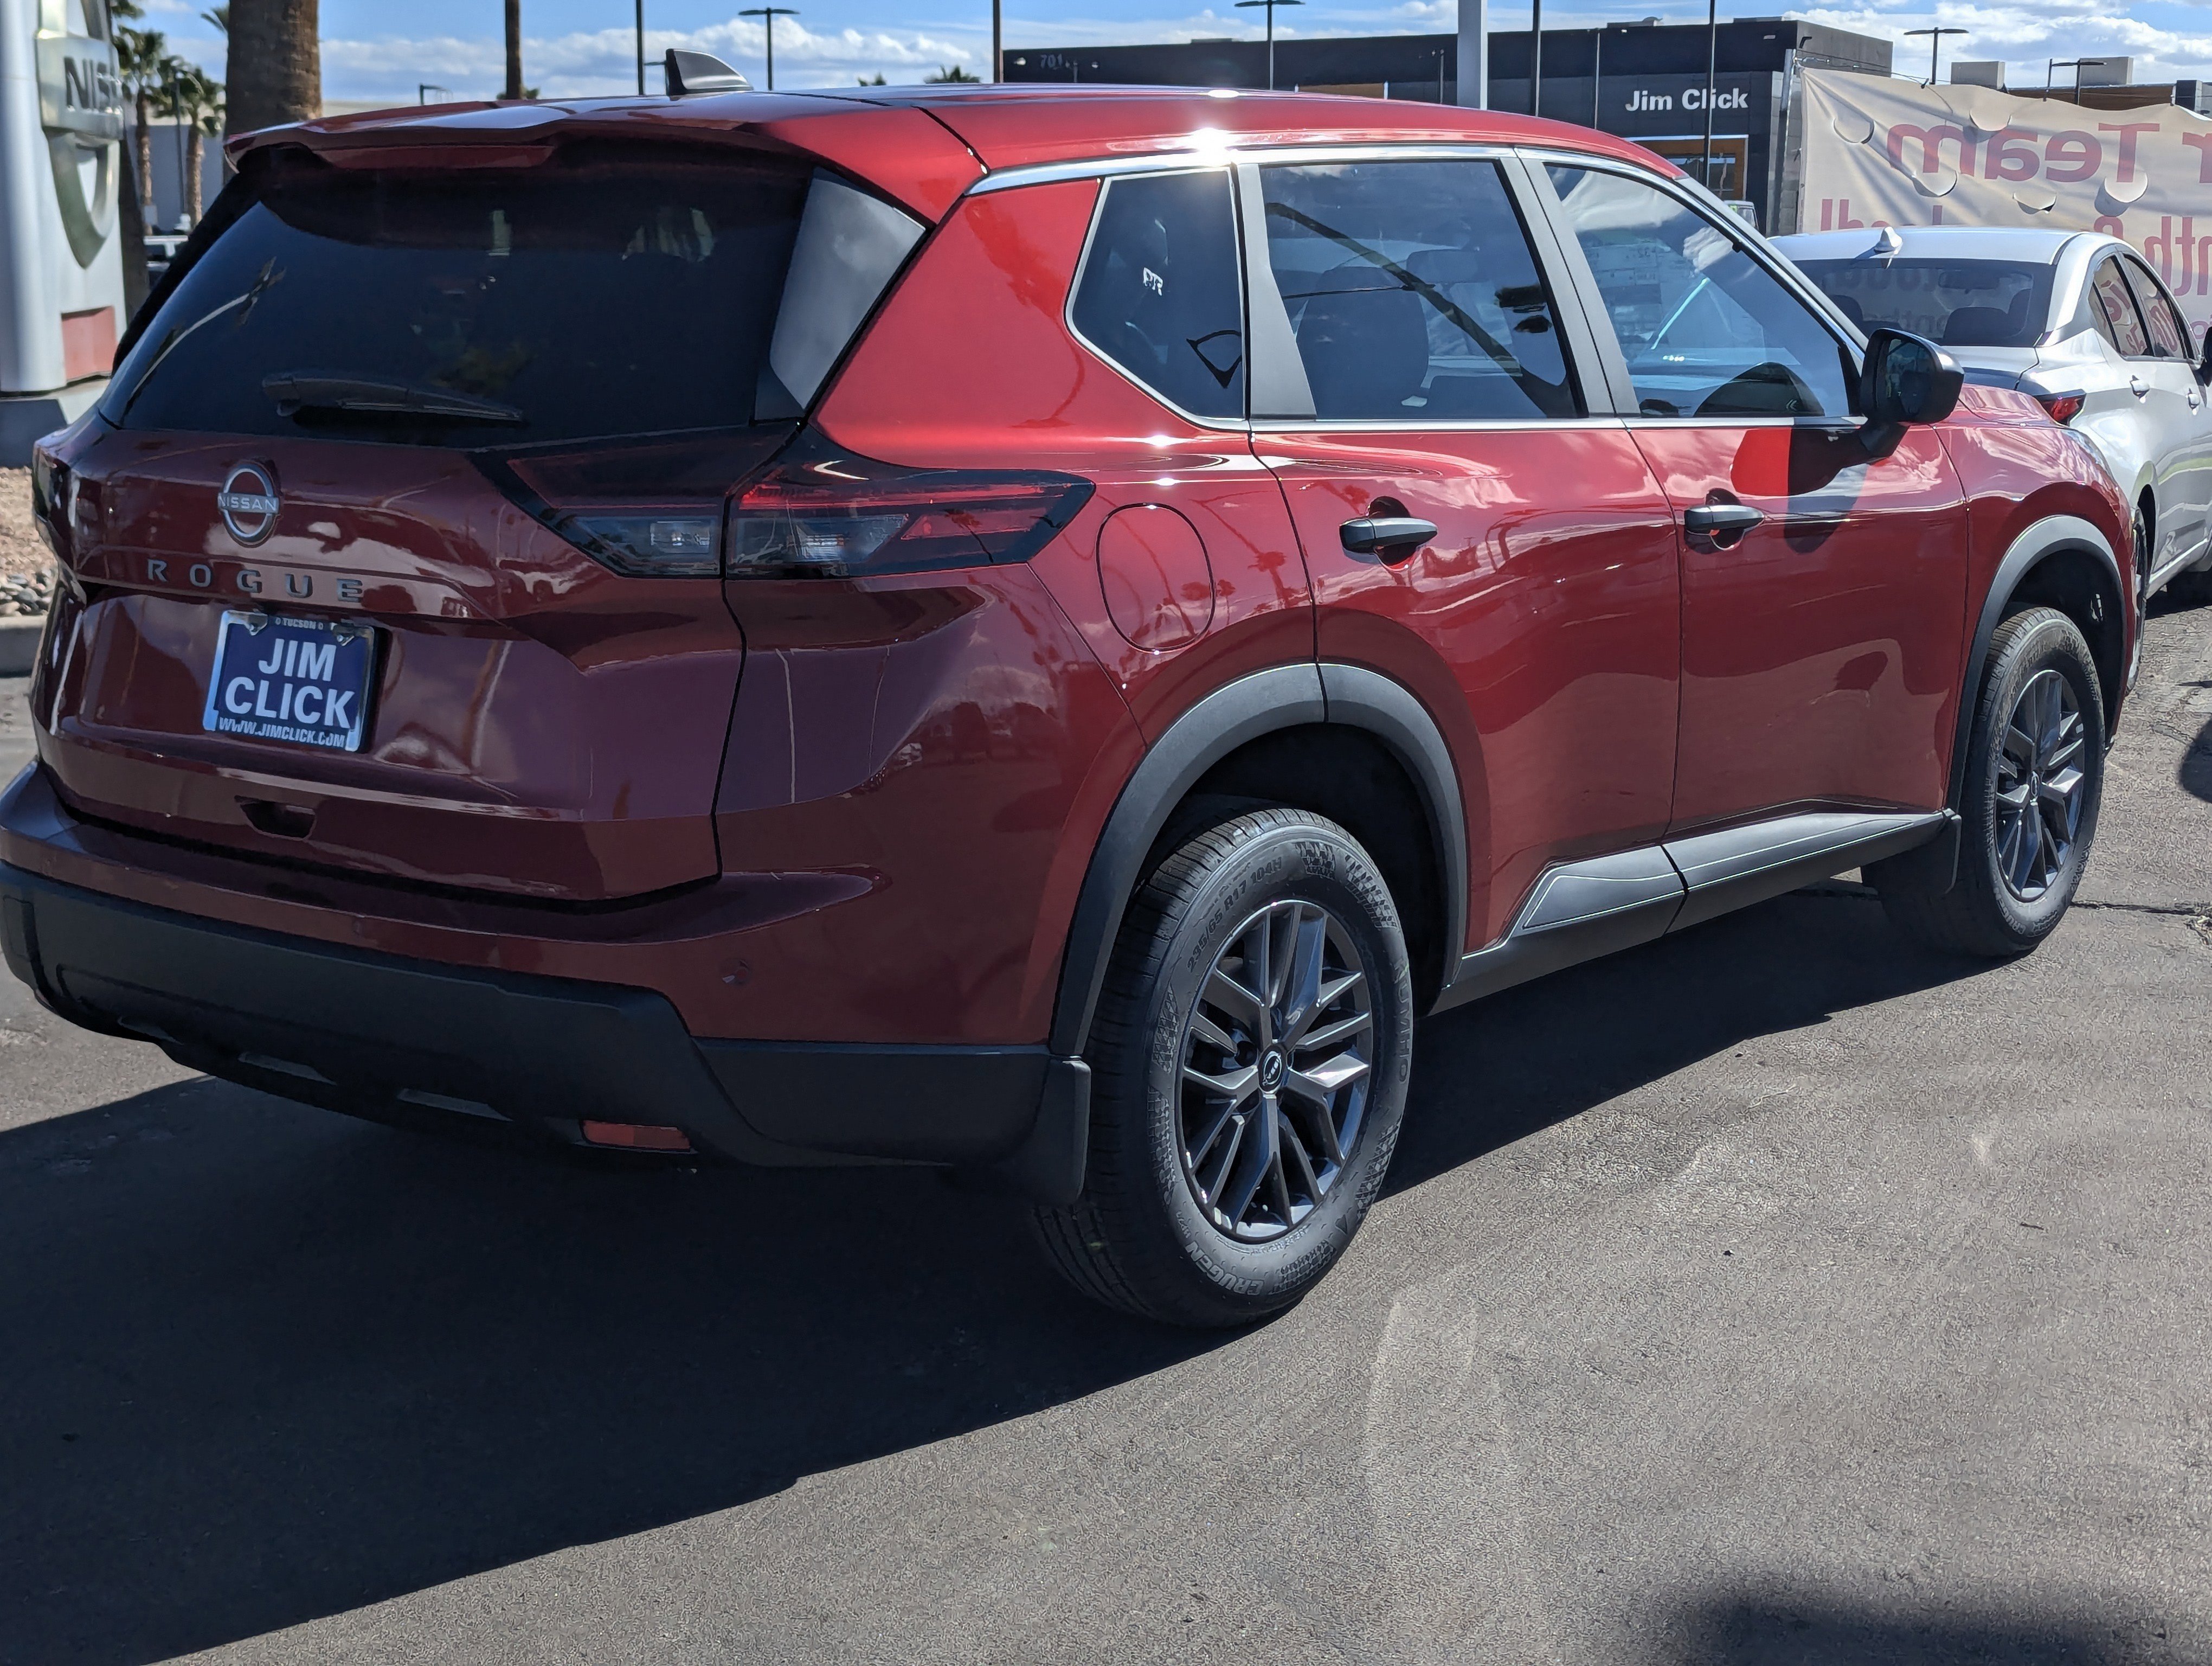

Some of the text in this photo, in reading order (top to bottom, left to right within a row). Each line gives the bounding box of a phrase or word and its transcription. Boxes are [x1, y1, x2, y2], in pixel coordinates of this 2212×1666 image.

[1625, 87, 1749, 112] Jim Click
[217, 494, 277, 511] NISSAN
[147, 558, 363, 603] ROGUE
[282, 617, 317, 630] TUCSON
[258, 638, 337, 682] JIM
[225, 676, 355, 729] CLICK
[219, 716, 345, 748] WWW.JIMCLICK.COM
[1187, 909, 1223, 973] 235/65
[1224, 879, 1247, 911] R17
[1394, 956, 1410, 1082] KUMHO
[1184, 1240, 1265, 1296] CRUGEN
